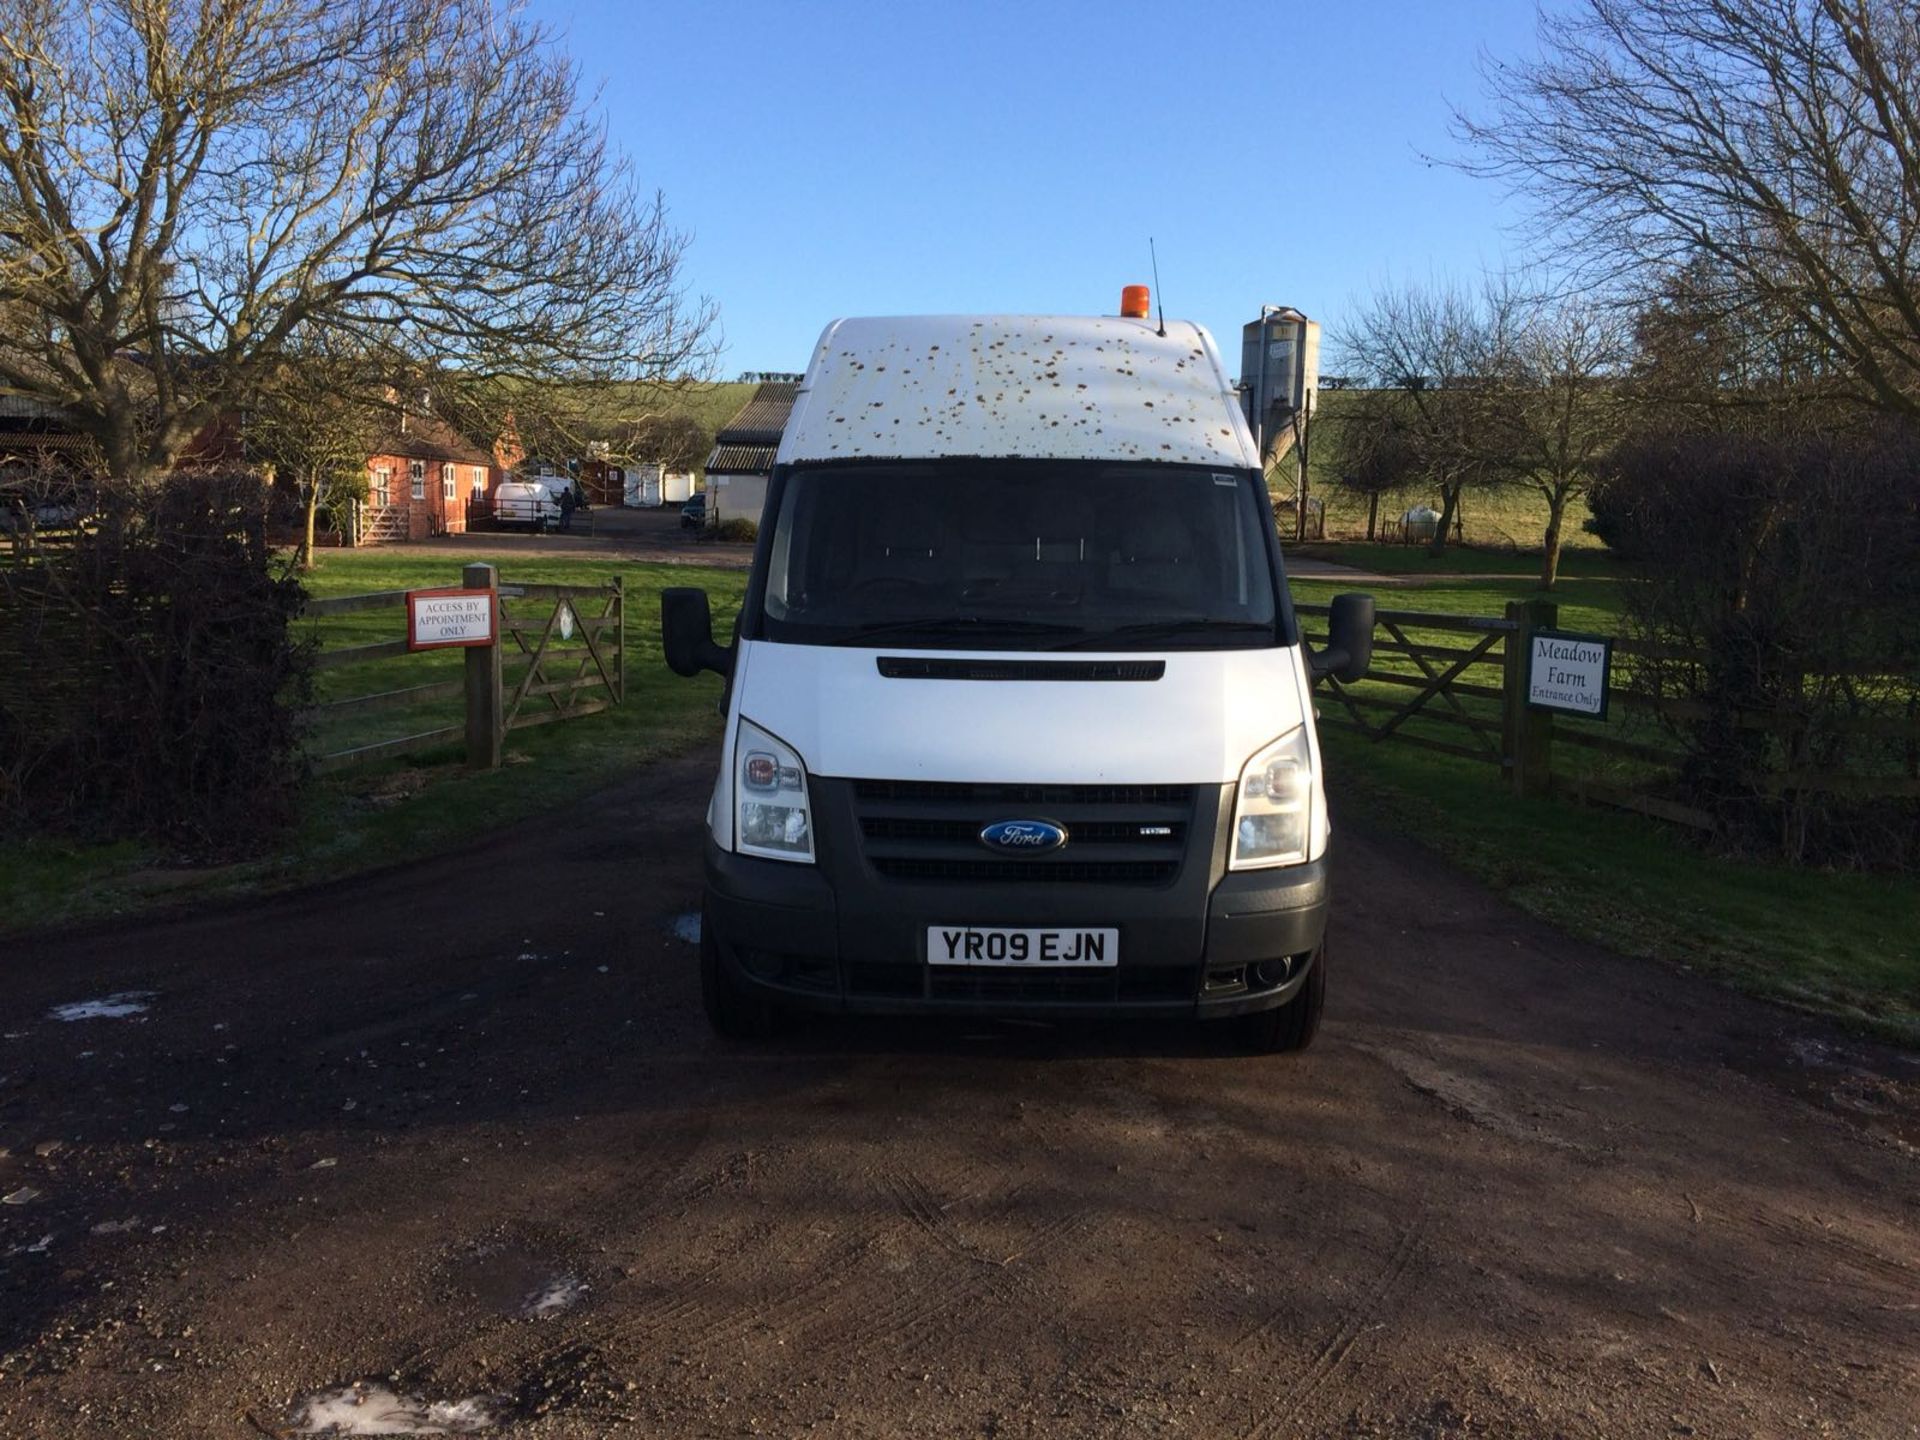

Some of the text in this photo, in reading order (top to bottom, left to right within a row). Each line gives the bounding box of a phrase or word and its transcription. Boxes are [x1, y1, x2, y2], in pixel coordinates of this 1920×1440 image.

[426, 601, 480, 613] ACCESS BY
[419, 613, 487, 625] APPOINTMENT
[440, 626, 467, 636] ONLY
[1537, 640, 1602, 664] Meadow
[1548, 666, 1586, 687] Farm
[1532, 686, 1600, 711] Entrance Only
[1000, 825, 1044, 845] Ford
[942, 931, 1105, 961] YR09 EJN
